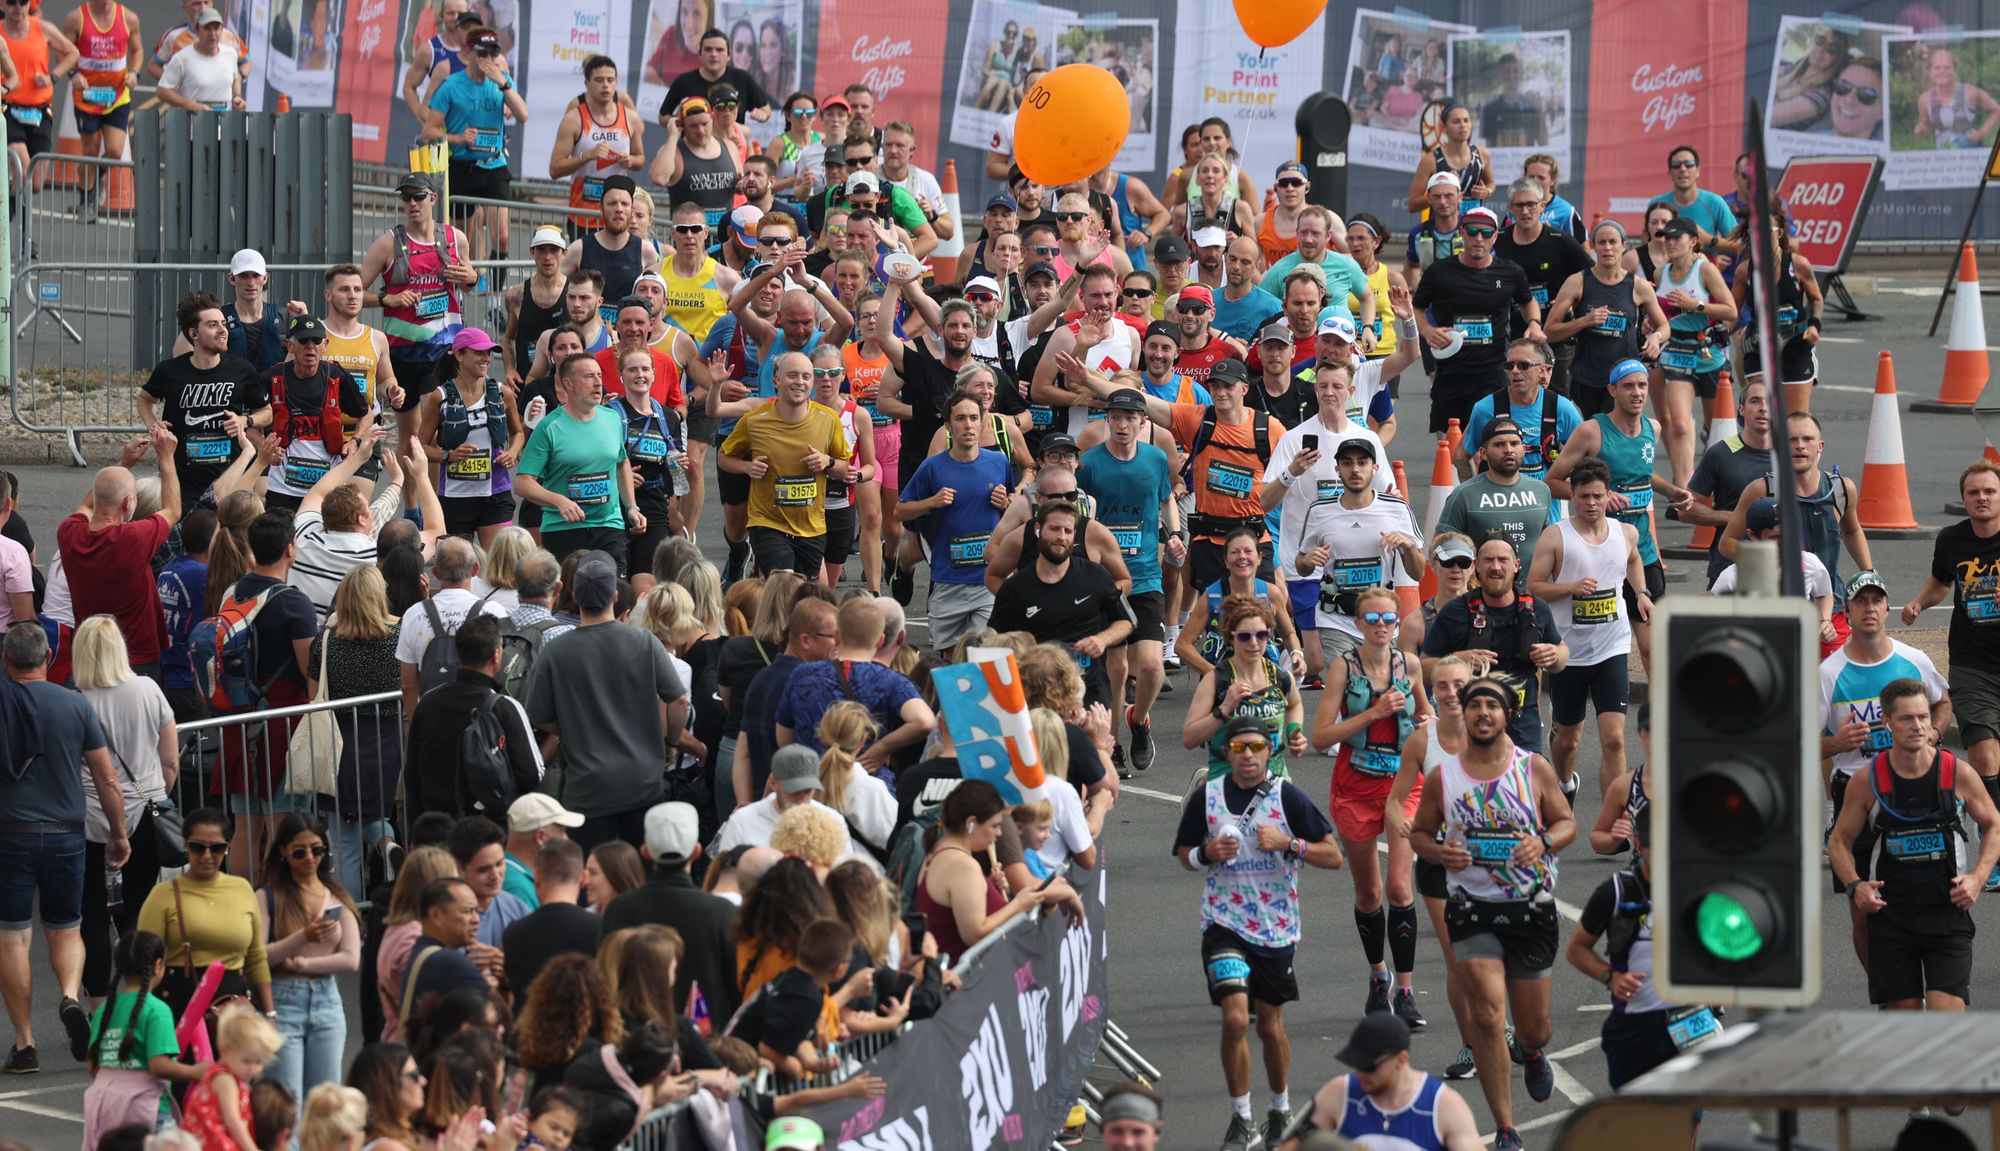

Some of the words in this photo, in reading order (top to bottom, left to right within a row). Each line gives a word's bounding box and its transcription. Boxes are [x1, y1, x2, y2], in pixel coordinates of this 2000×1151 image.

[573, 11, 600, 27] Your
[570, 29, 600, 45] Print
[552, 44, 597, 63] Partn
[852, 35, 913, 63] Custom
[1237, 51, 1279, 70] Your
[861, 67, 906, 102] Gifts
[1233, 71, 1280, 88] Print
[1631, 63, 1703, 92] Custom
[1204, 86, 1276, 105] Partner
[1641, 91, 1696, 133] Gifts
[592, 131, 620, 142] GABE
[691, 172, 735, 183] WALTERS
[1786, 182, 1845, 206] ROAD
[1792, 219, 1842, 245] OSED
[667, 298, 705, 308] STRIDERS
[679, 291, 705, 300] ALBANS
[855, 366, 887, 379] Kerry
[180, 382, 235, 409] NIKE
[203, 442, 230, 456] 22214
[461, 459, 488, 472] 24154
[584, 482, 609, 496] 22084
[1222, 473, 1250, 490] 22019
[790, 484, 816, 498] 31579
[1479, 491, 1538, 509] ADAM
[1502, 522, 1524, 533] THIS
[1118, 531, 1139, 545] 0757
[1352, 569, 1378, 583] 20761
[1589, 600, 1615, 614] 24141
[1456, 808, 1522, 826] CARLTON
[1906, 835, 1940, 851] 20392
